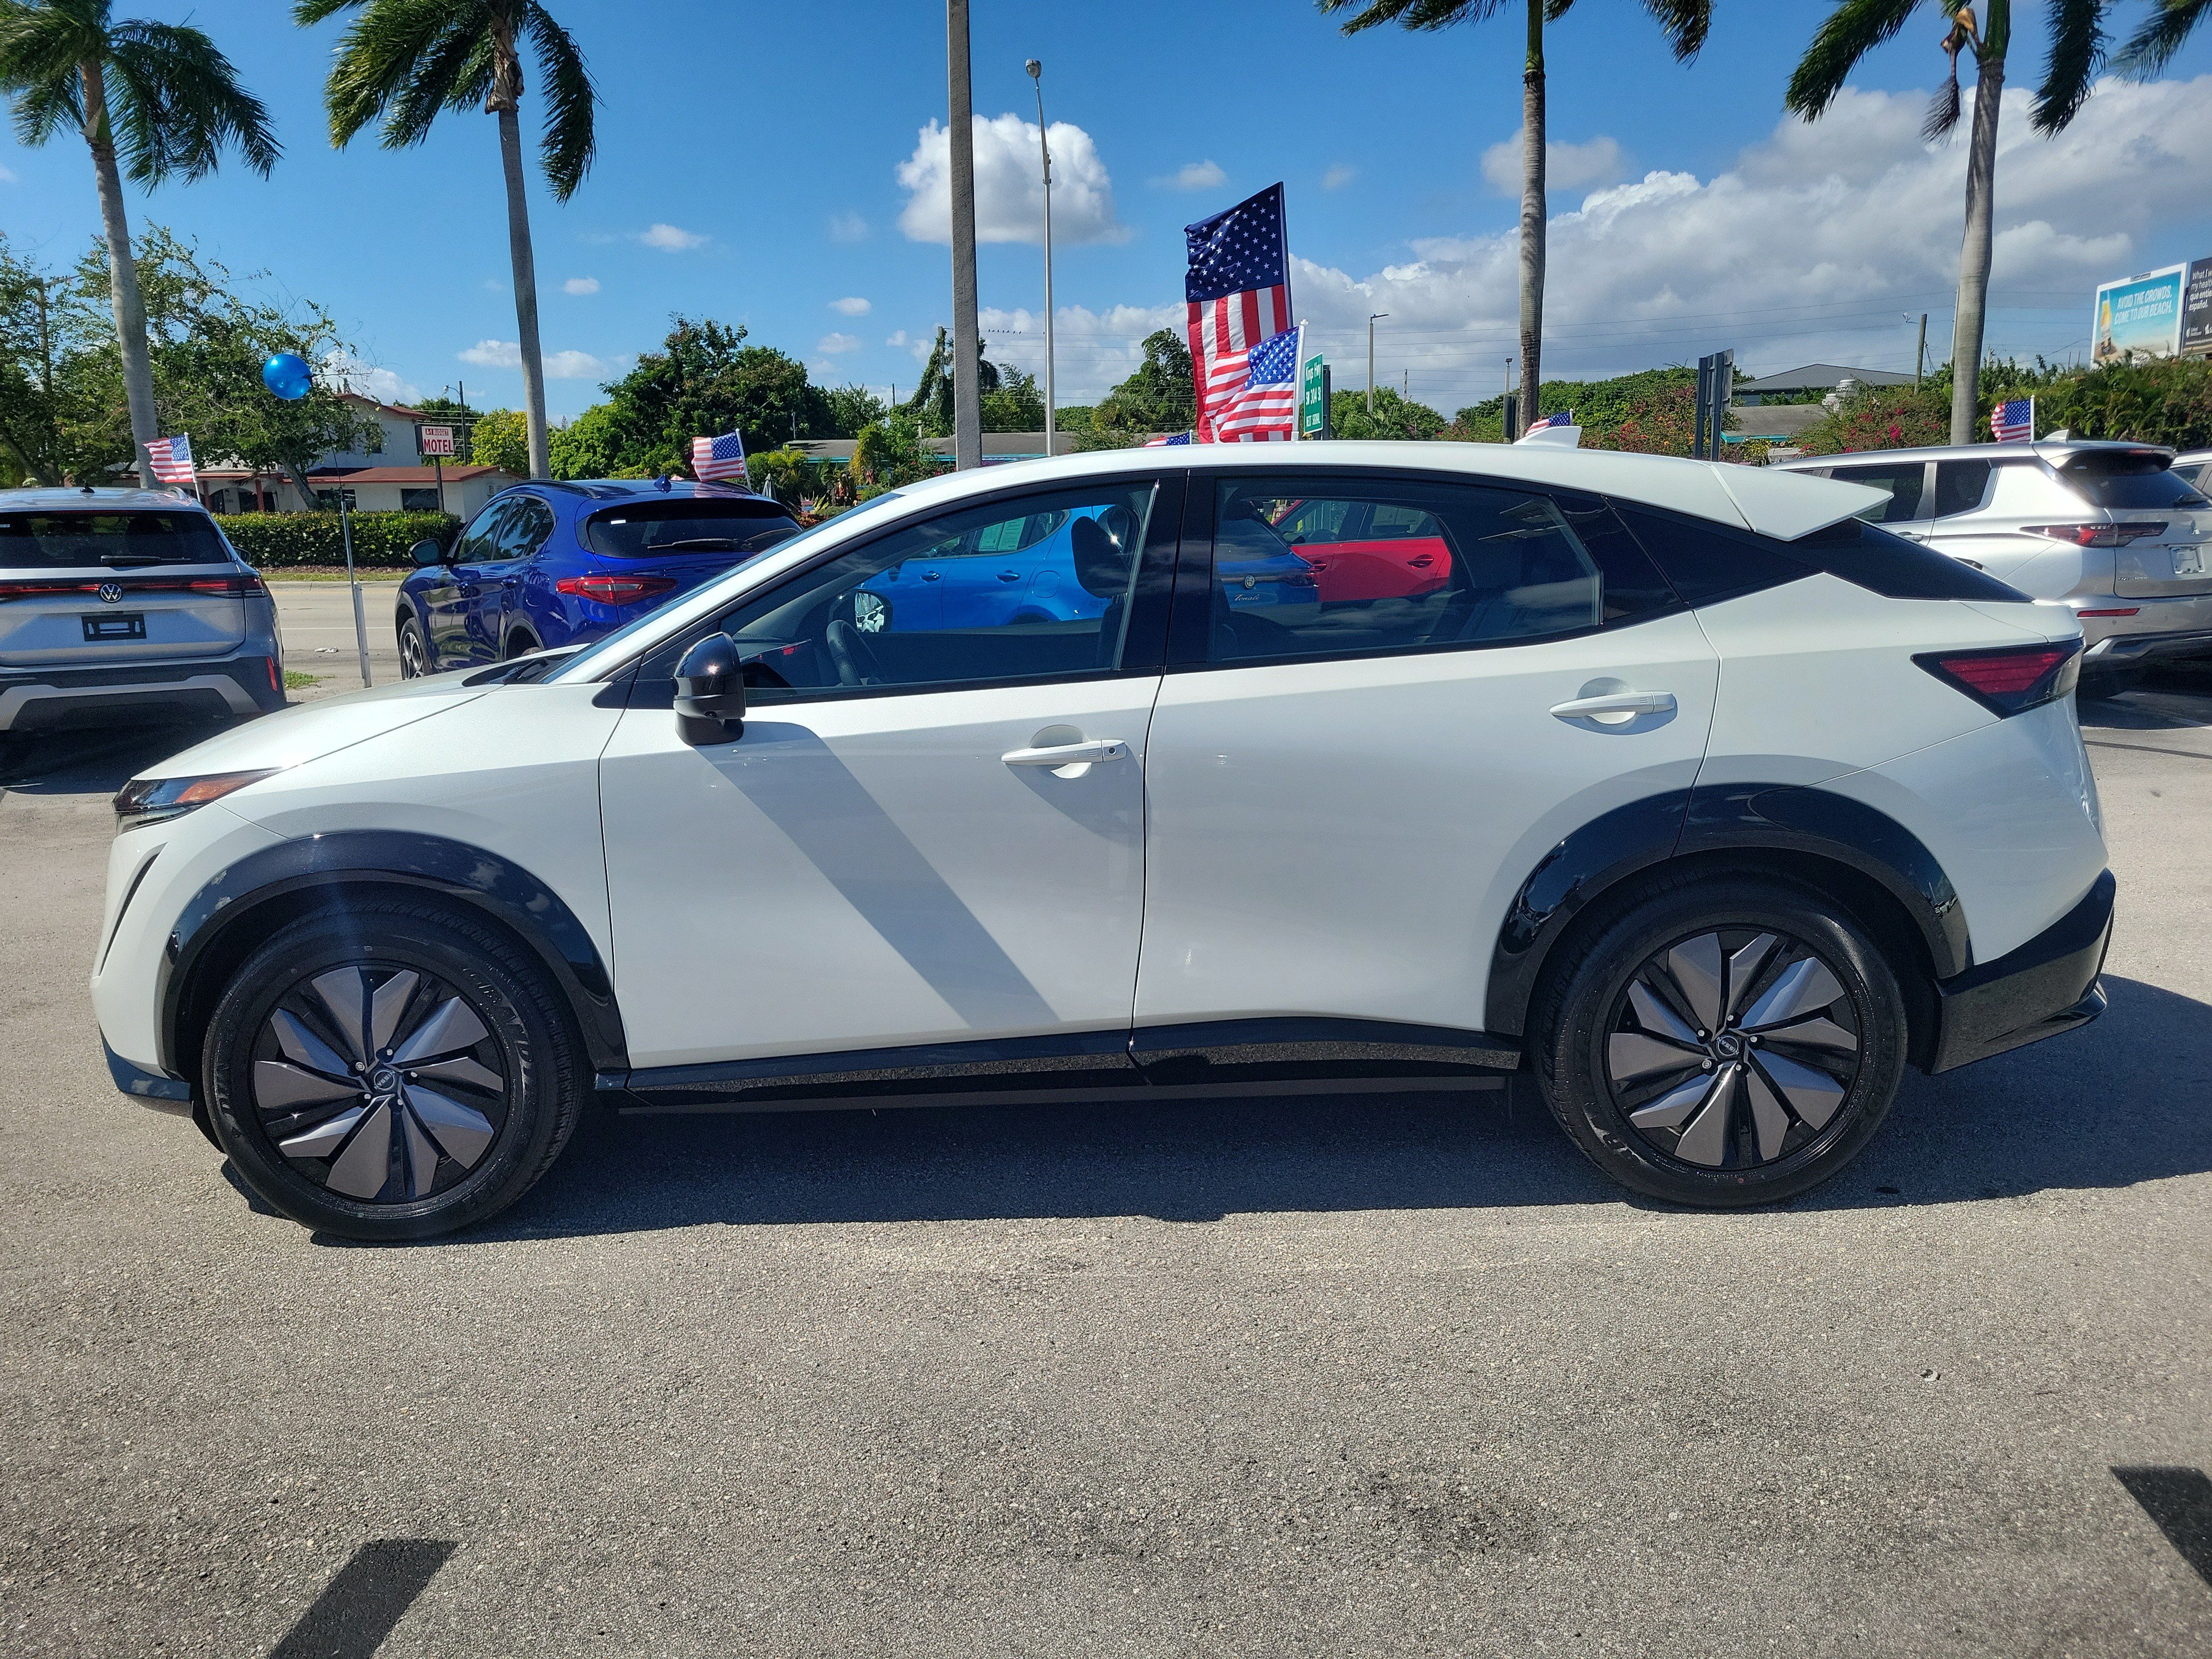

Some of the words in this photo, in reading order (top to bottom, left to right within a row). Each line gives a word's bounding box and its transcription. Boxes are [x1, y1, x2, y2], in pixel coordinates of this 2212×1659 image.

[2192, 270, 2204, 280] What
[2205, 269, 2208, 278] I
[2191, 283, 2199, 292] my
[2118, 295, 2133, 311] AVOID
[2134, 291, 2145, 307] THE
[2145, 285, 2172, 303] CROWDS.
[2190, 292, 2199, 302] que
[2189, 298, 2208, 312] español.
[2114, 310, 2130, 325] COME
[2130, 308, 2138, 321] TO
[2137, 306, 2150, 319] OUR
[2149, 300, 2172, 317] BEACH.
[424, 439, 454, 453] MOTEL
[1717, 1036, 1739, 1055] NISSAN
[374, 1070, 396, 1090] NISSAN
